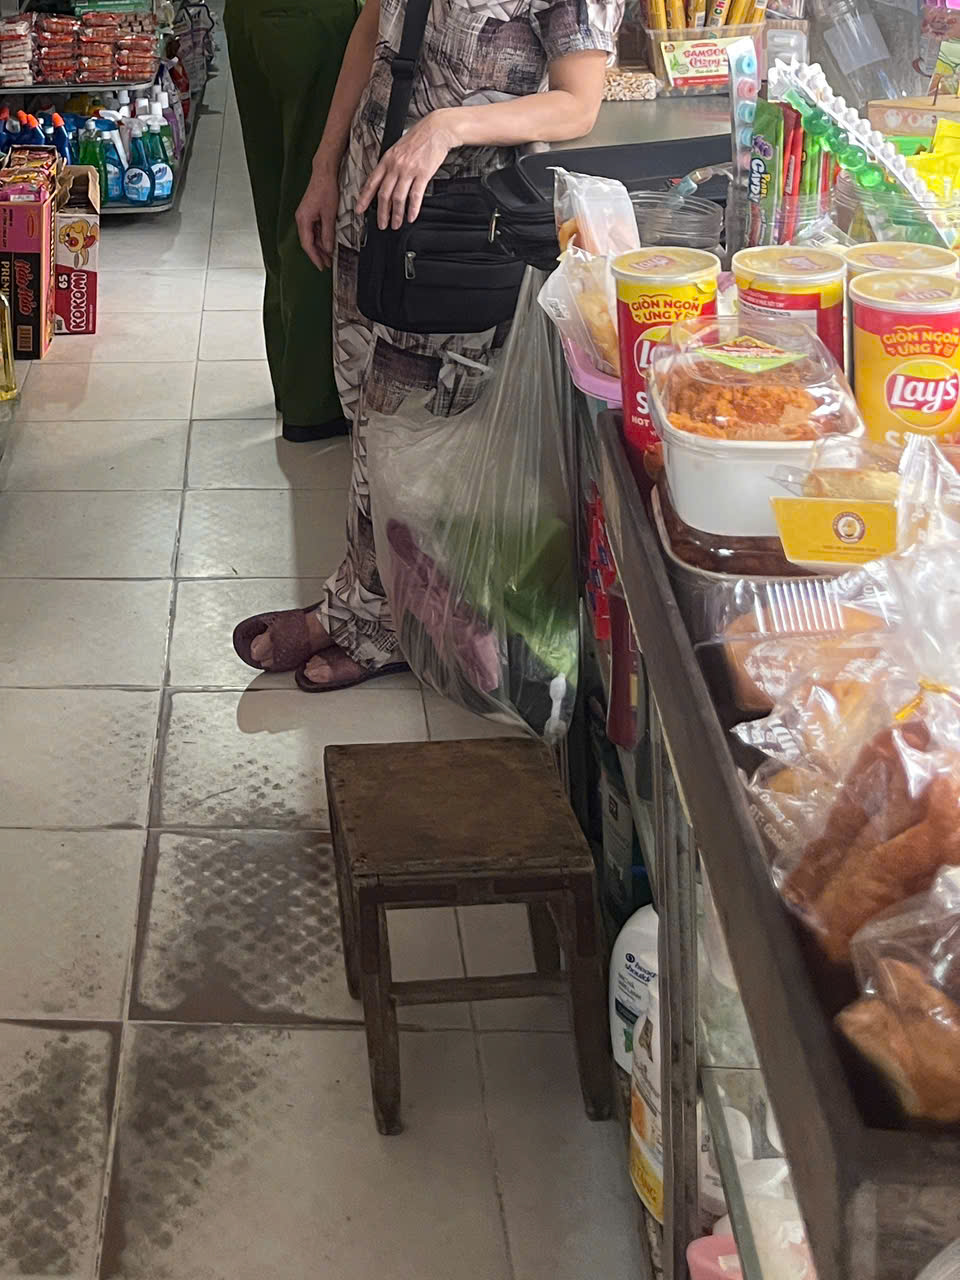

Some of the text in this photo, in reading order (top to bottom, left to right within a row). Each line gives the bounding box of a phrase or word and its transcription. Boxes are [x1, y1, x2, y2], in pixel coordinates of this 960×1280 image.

[59, 274, 69, 288] 65
[70, 272, 87, 332] KOKOMI
[891, 375, 958, 413] Lay's
[632, 415, 650, 427] HOT
